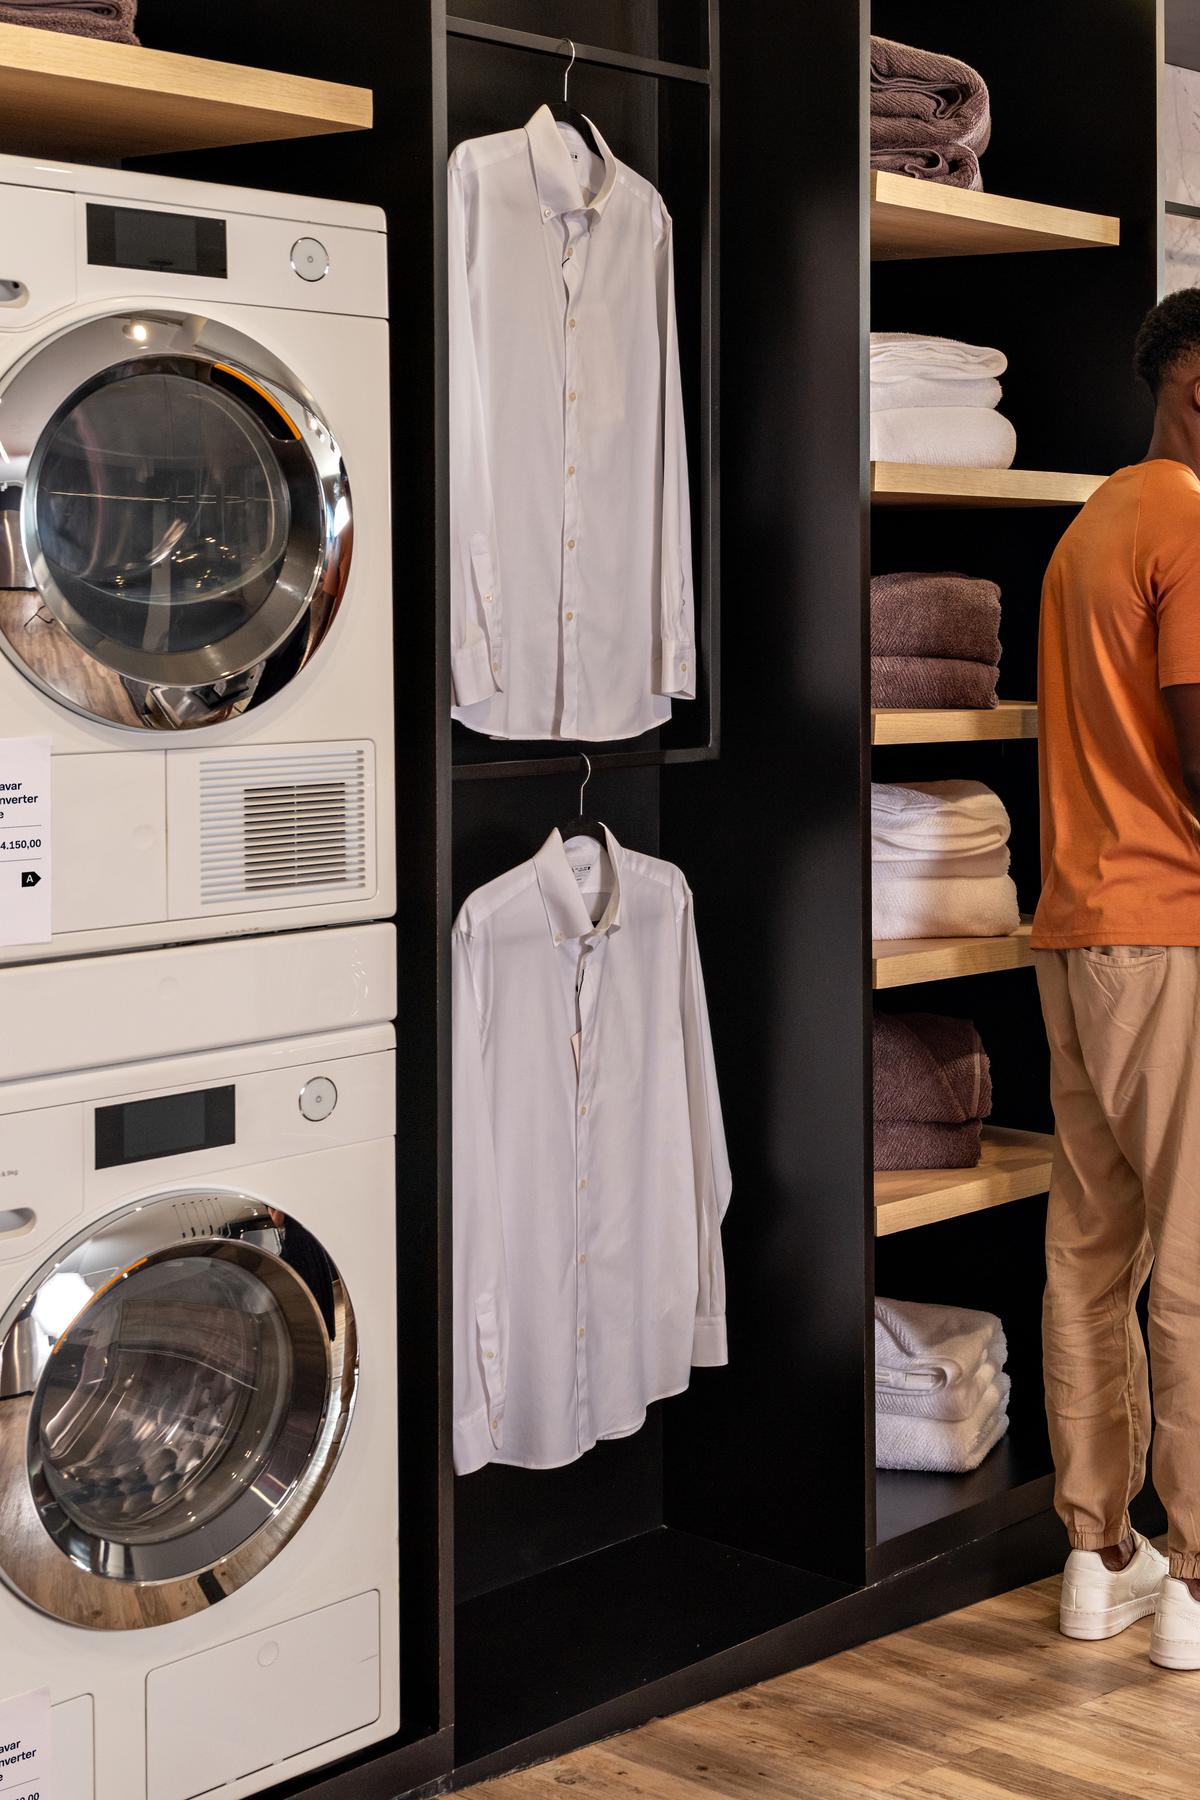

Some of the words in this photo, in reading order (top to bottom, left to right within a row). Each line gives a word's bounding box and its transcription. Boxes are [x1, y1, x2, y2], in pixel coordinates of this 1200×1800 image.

[0, 783, 22, 791] avar
[0, 795, 38, 805] nverter
[0, 839, 41, 850] 4.150,00
[26, 874, 34, 883] A
[0, 1740, 21, 1754] avar
[0, 1749, 36, 1767] nverter
